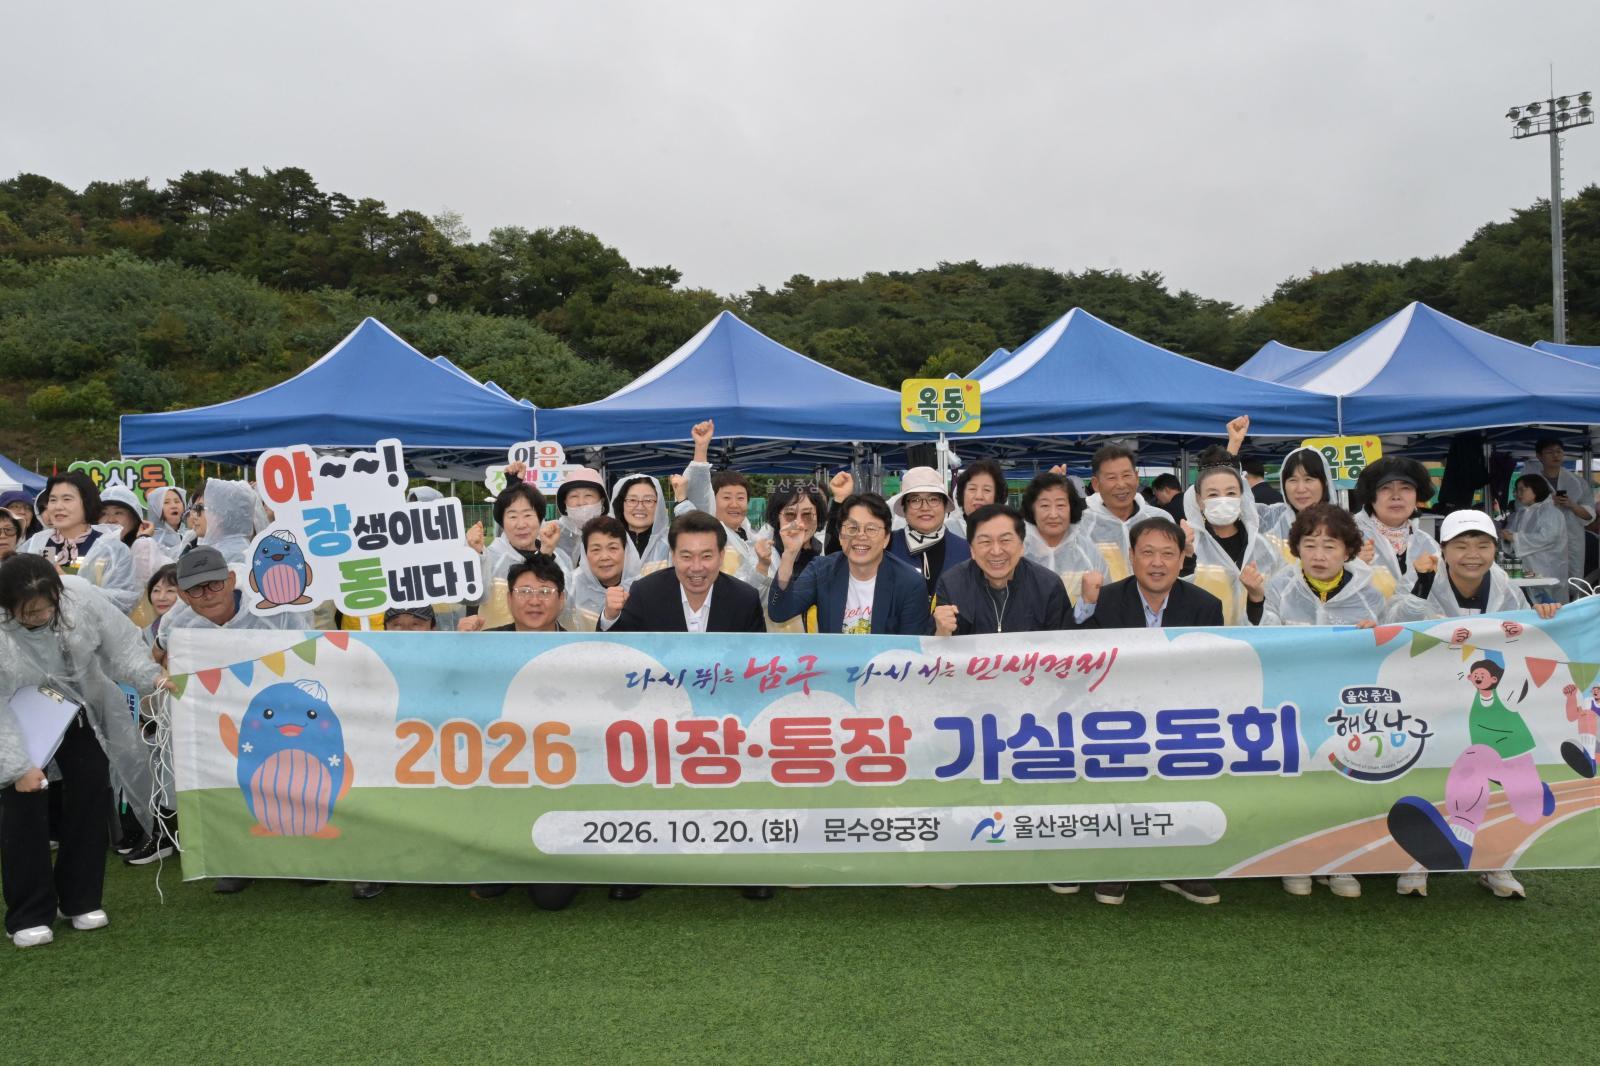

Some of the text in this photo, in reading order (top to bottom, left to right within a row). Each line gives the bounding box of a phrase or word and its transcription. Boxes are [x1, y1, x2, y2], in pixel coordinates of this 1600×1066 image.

[917, 387, 965, 424] 옥동
[514, 446, 559, 468] 야음
[76, 464, 168, 502] 산동
[302, 503, 459, 557] 장생이네
[625, 647, 1118, 695] 다시 뛰는 남구 다시 서는 민생경제
[395, 720, 577, 786] 2026
[934, 704, 1300, 781] 가실운동회
[583, 817, 941, 844] 2026. 10. 20. (화) 문수양궁장
[1013, 812, 1175, 839] 울산광역시 남구
